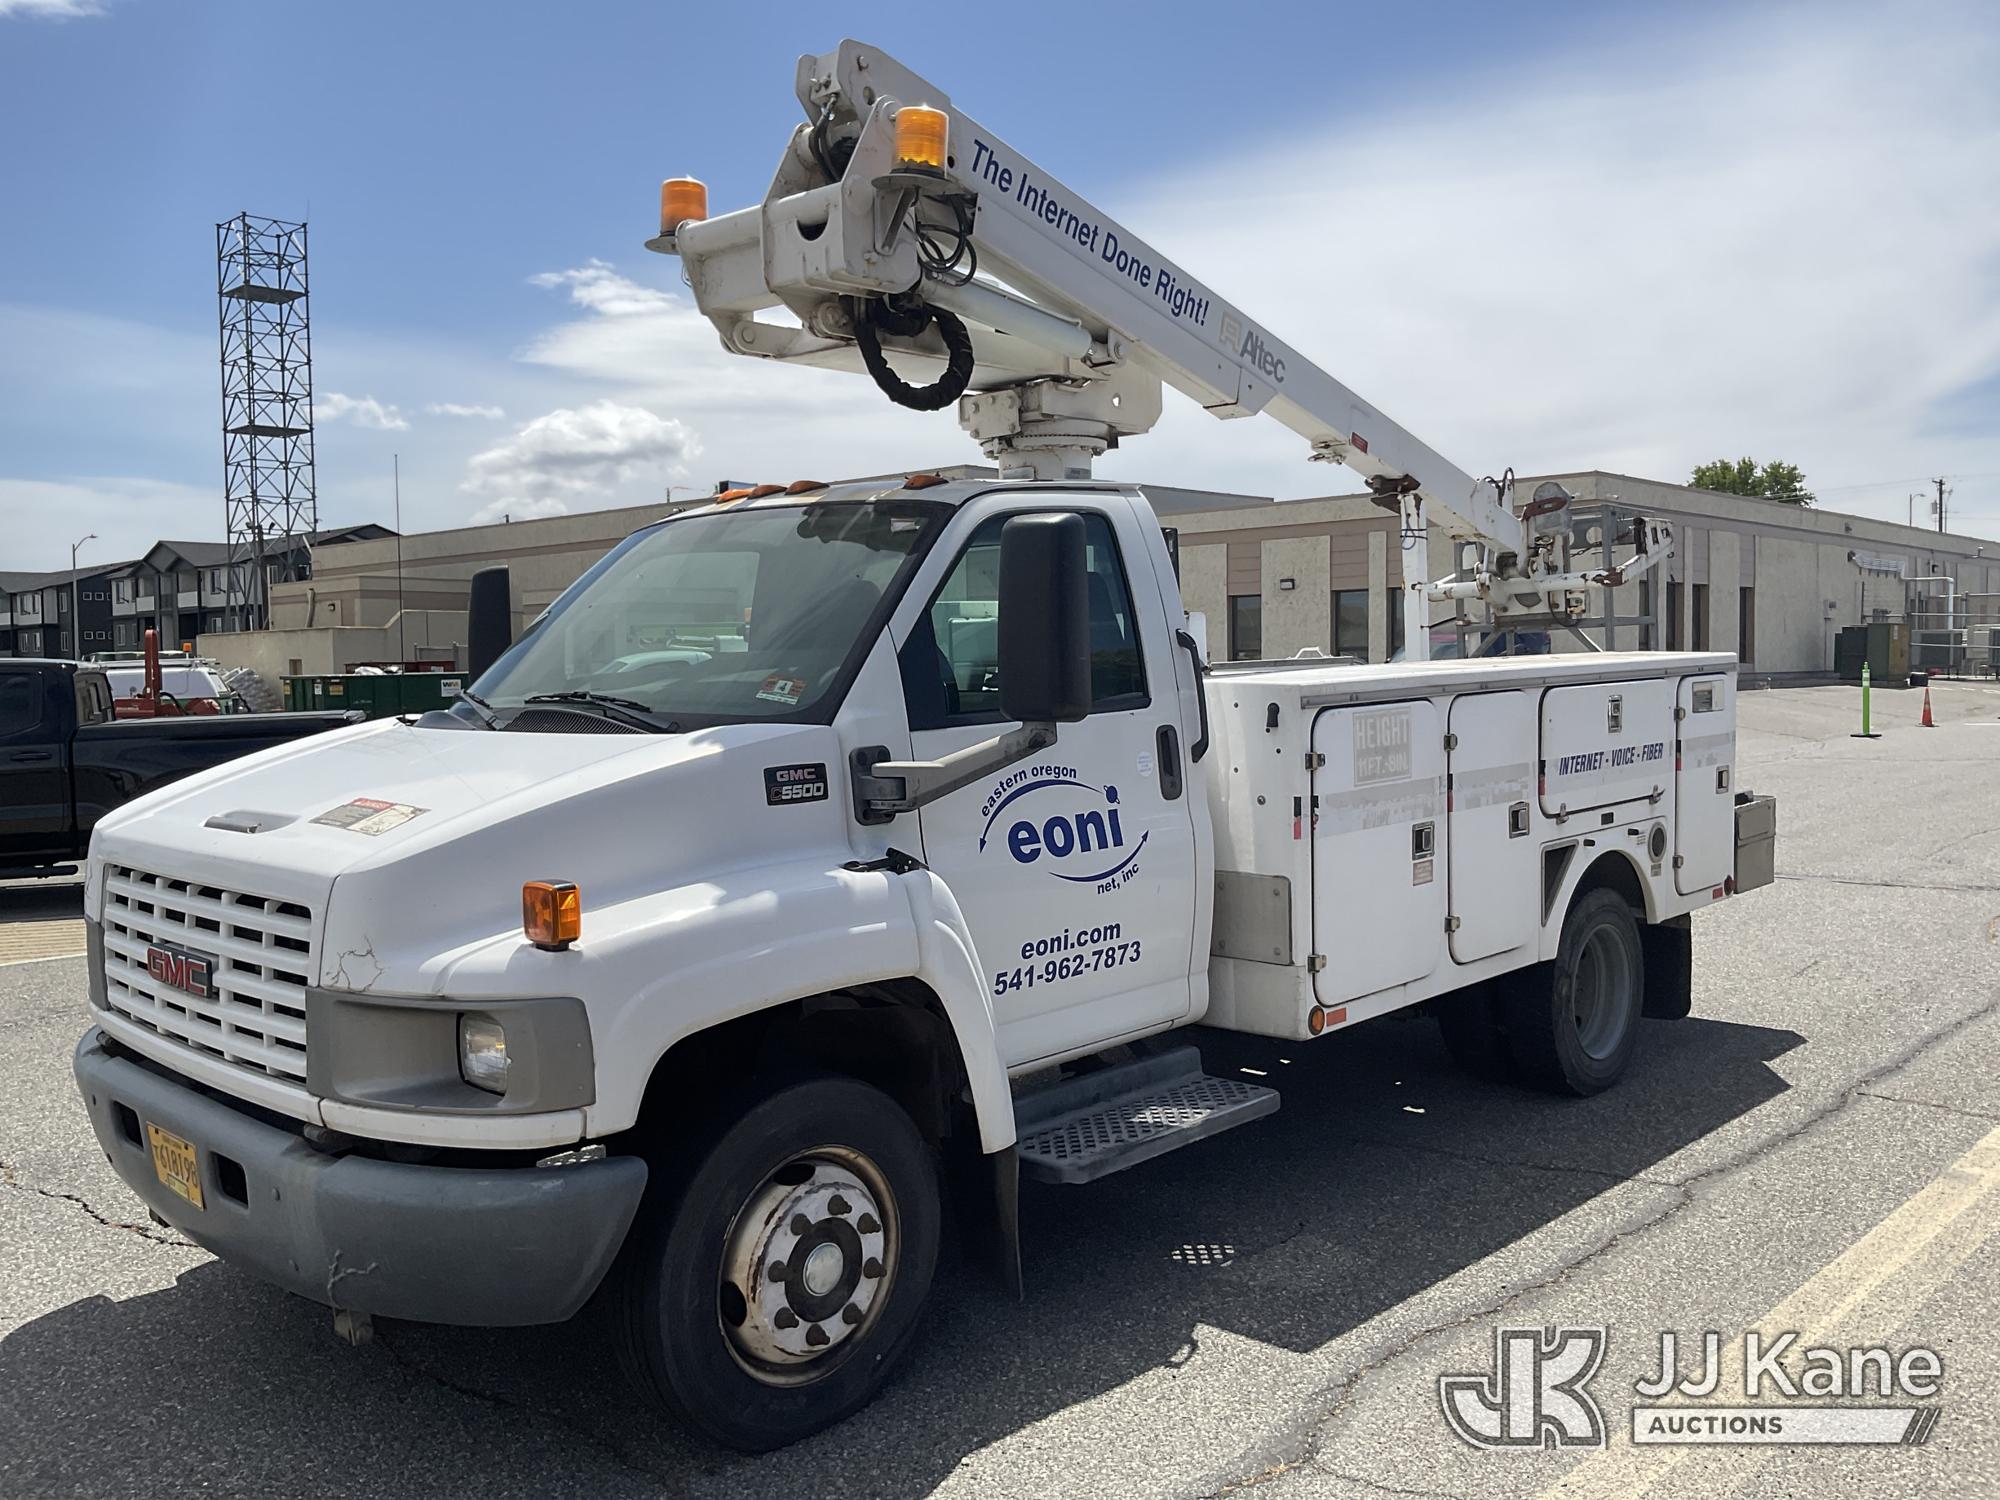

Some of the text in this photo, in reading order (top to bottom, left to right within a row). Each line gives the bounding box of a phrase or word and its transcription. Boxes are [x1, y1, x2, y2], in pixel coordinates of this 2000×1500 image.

[972, 139, 1209, 326] The Internet Done Right!
[1240, 329, 1286, 383] Altec
[1356, 714, 1409, 750] HEIGHT
[776, 768, 816, 782] GMC
[1559, 751, 1604, 776] INTERNET
[1611, 746, 1635, 767] VOICE
[1641, 742, 1664, 762] FIBER
[771, 782, 825, 801] C5500
[981, 765, 1077, 817] eastern oregon
[1007, 785, 1124, 864] eoni
[1097, 863, 1140, 894] net, inc
[1021, 922, 1121, 960] eoni.com
[147, 946, 207, 997] GMC
[994, 941, 1141, 996] 541-962-7873
